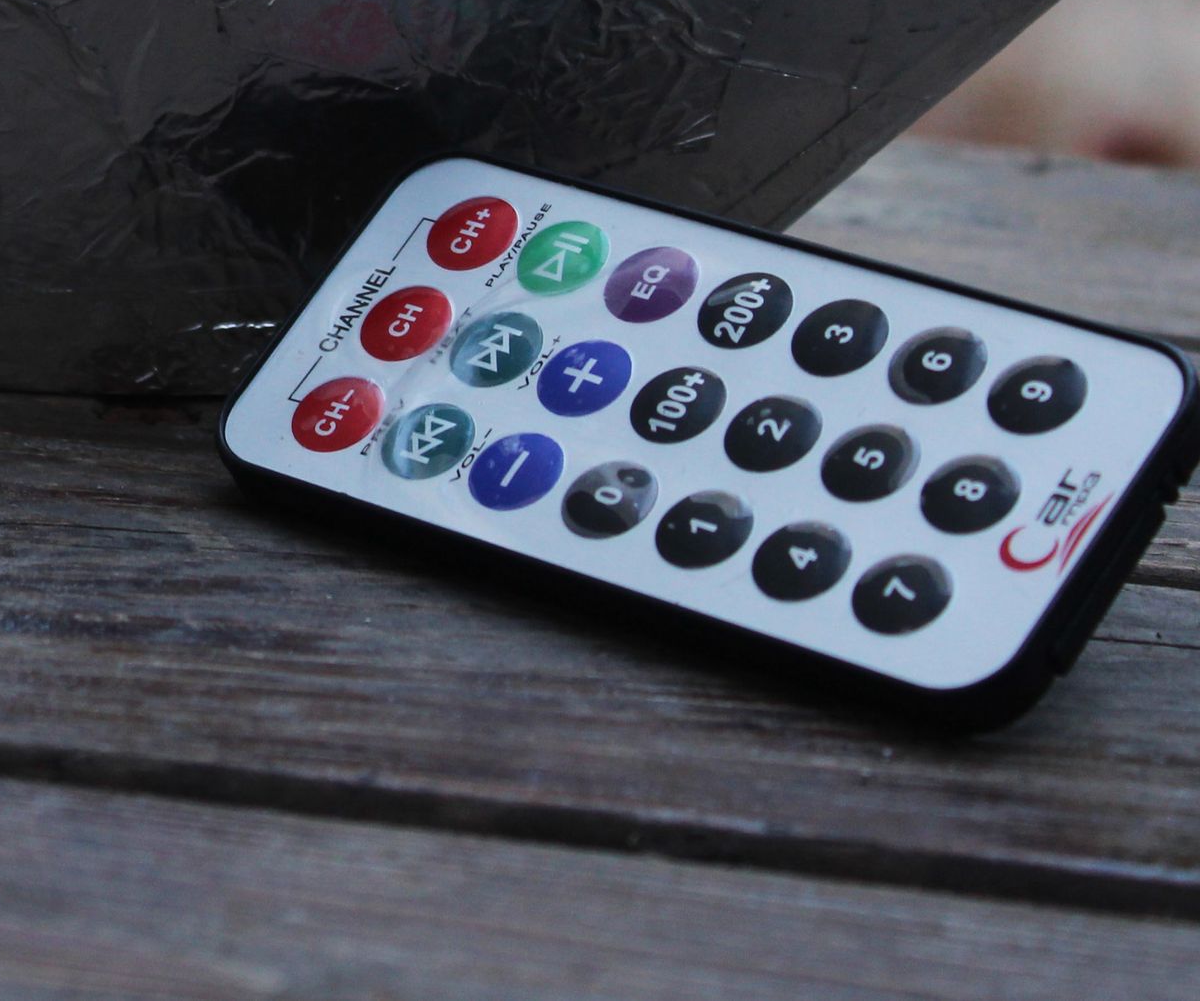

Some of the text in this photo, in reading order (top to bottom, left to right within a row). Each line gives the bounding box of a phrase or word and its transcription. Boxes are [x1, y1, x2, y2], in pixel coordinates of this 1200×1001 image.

[450, 208, 492, 255] CH+
[485, 202, 552, 288] PLAY/PAUSE
[631, 264, 670, 301] EQ
[319, 265, 397, 353] CHANNEL
[388, 303, 424, 338] CH
[713, 278, 772, 344] 200+
[824, 323, 855, 344] 3
[517, 335, 562, 391] VOL+
[921, 351, 952, 371] 6
[648, 372, 705, 432] 100+
[1020, 380, 1053, 402] 9
[757, 418, 791, 441] 2
[853, 446, 885, 469] 5
[594, 486, 623, 505] 0
[953, 479, 987, 501] 8
[689, 517, 718, 534] 1
[787, 546, 818, 569] 4
[883, 577, 917, 601] 7
